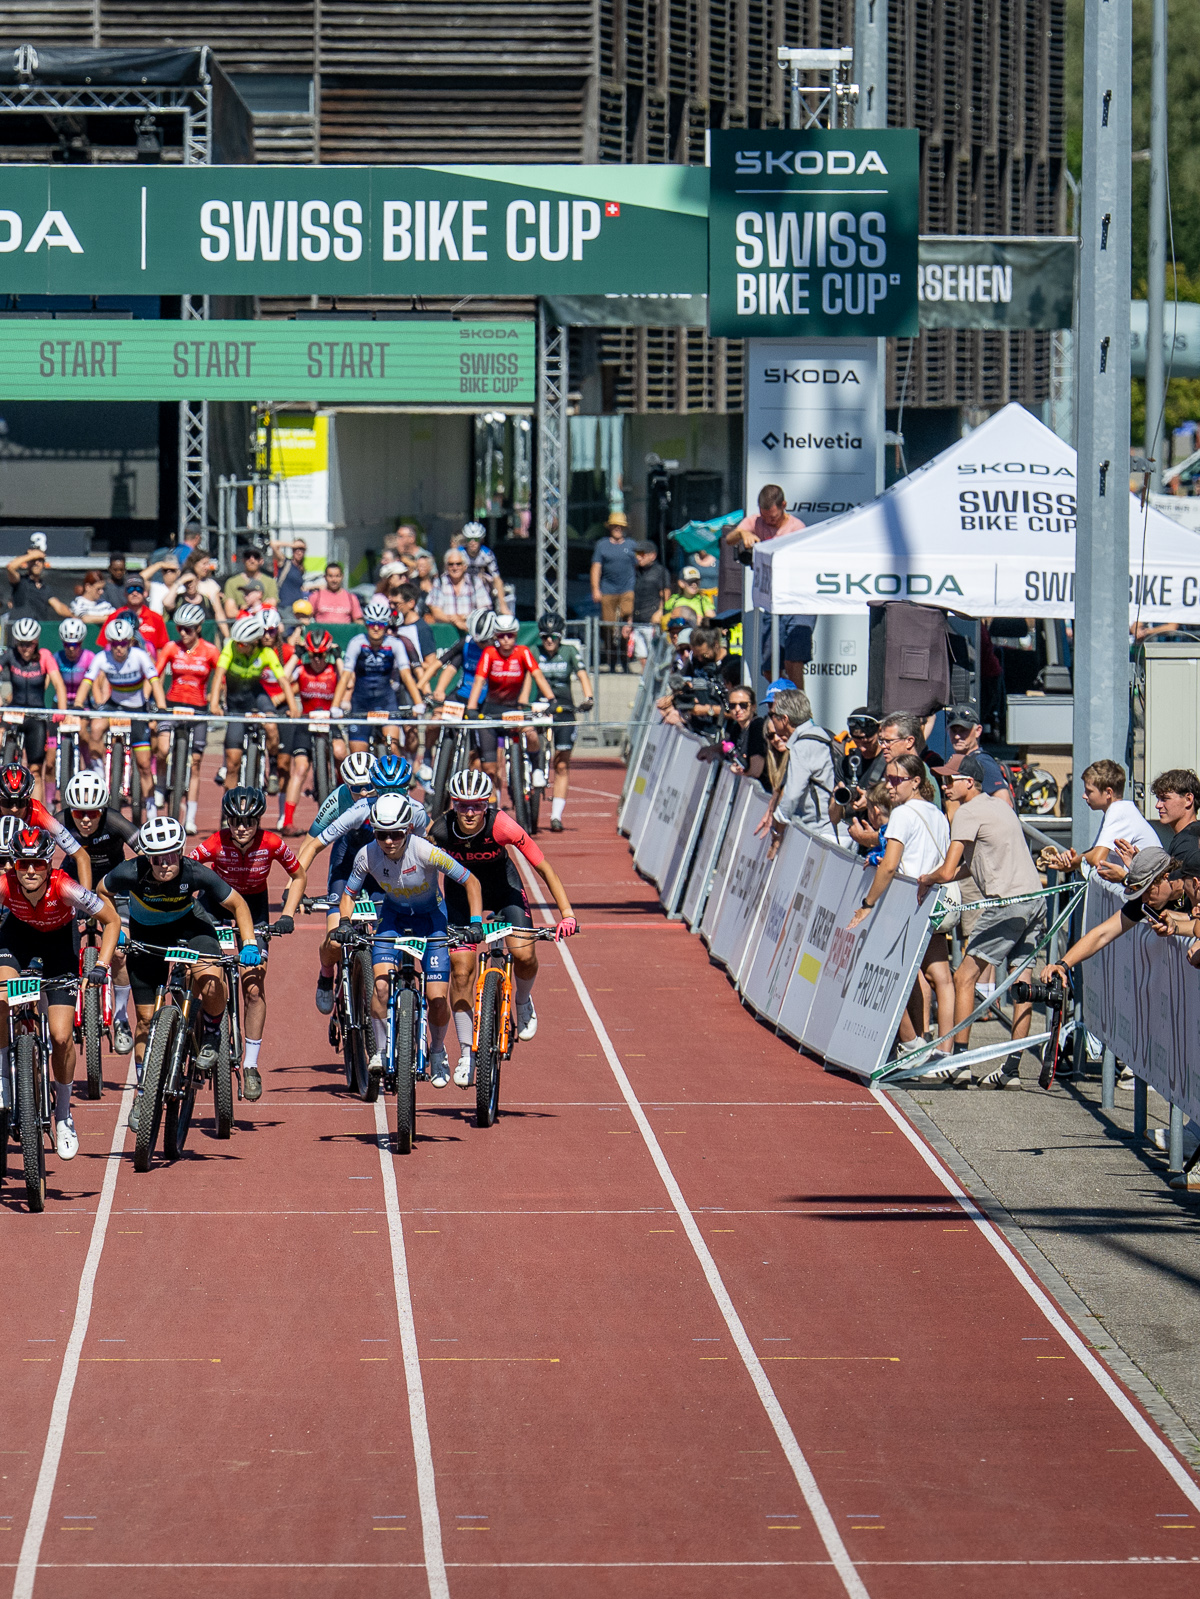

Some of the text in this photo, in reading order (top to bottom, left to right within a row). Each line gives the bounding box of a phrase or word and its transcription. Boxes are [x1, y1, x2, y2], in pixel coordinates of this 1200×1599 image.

[200, 200, 363, 262] SWISS
[383, 200, 488, 262] BIKE
[506, 200, 601, 262] CUP
[735, 211, 887, 269] SWISS
[736, 273, 888, 316] BIKE CUP
[39, 341, 390, 379] START START START
[460, 353, 518, 376] SWISS
[460, 377, 518, 394] BIKE CUP
[782, 432, 863, 450] helvetia
[959, 490, 1078, 516] SWISS
[960, 514, 1078, 533] BIKE CUP
[8, 979, 41, 997] 1103
